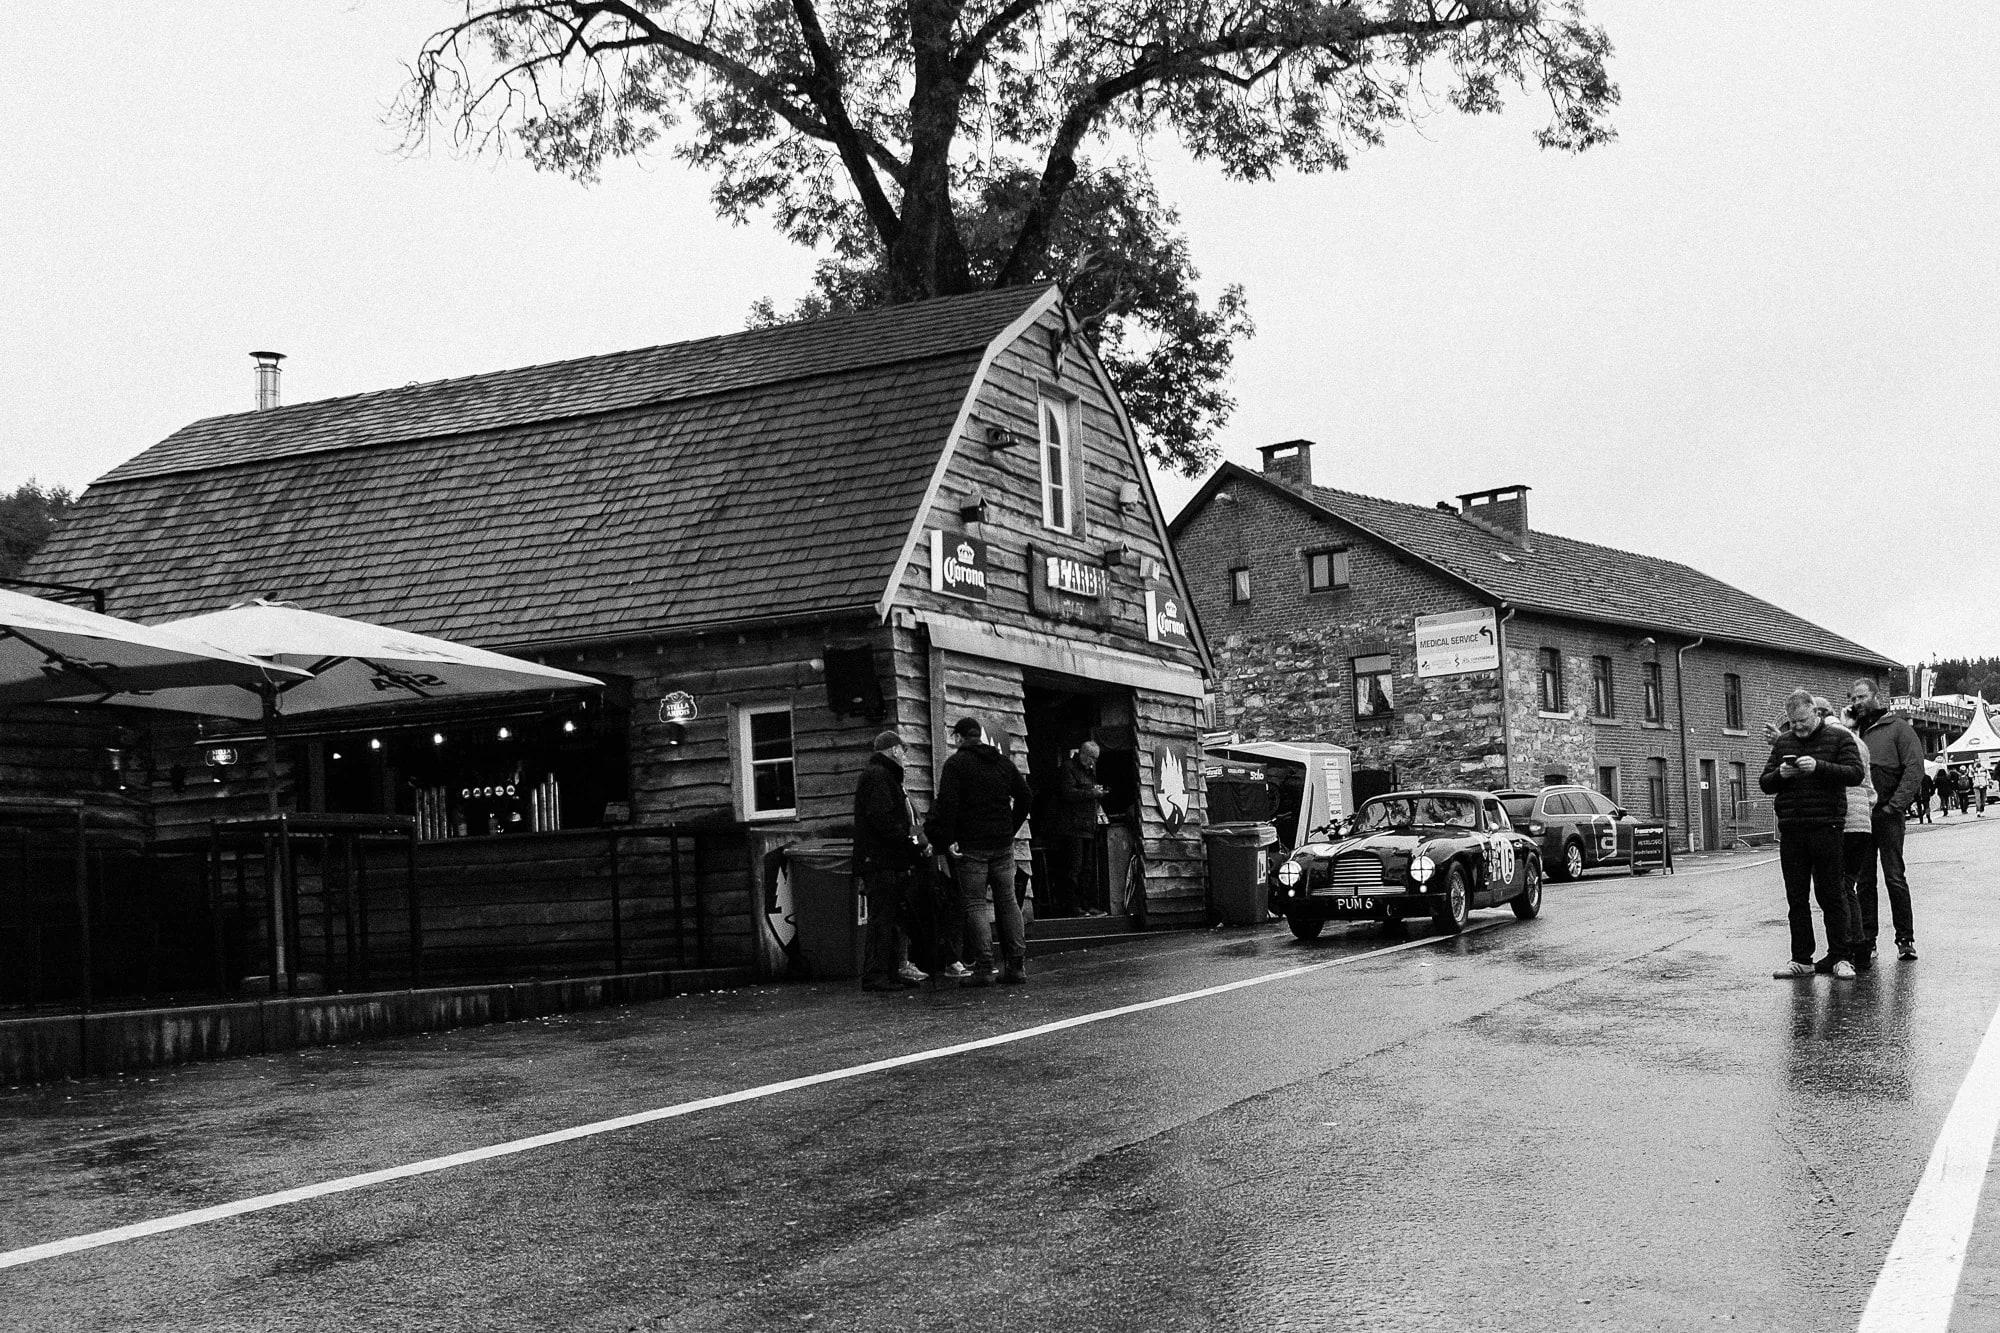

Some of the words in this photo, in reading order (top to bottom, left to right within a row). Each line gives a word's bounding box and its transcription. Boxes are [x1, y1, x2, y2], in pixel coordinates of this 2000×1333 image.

[944, 556, 986, 588] Corona
[1158, 612, 1187, 637] Corona
[1420, 638, 1449, 648] MEDICAL
[1451, 634, 1479, 644] SERVICE
[667, 709, 690, 717] ARTOIS
[1338, 898, 1362, 909] PUM
[1365, 898, 1373, 909] 6
